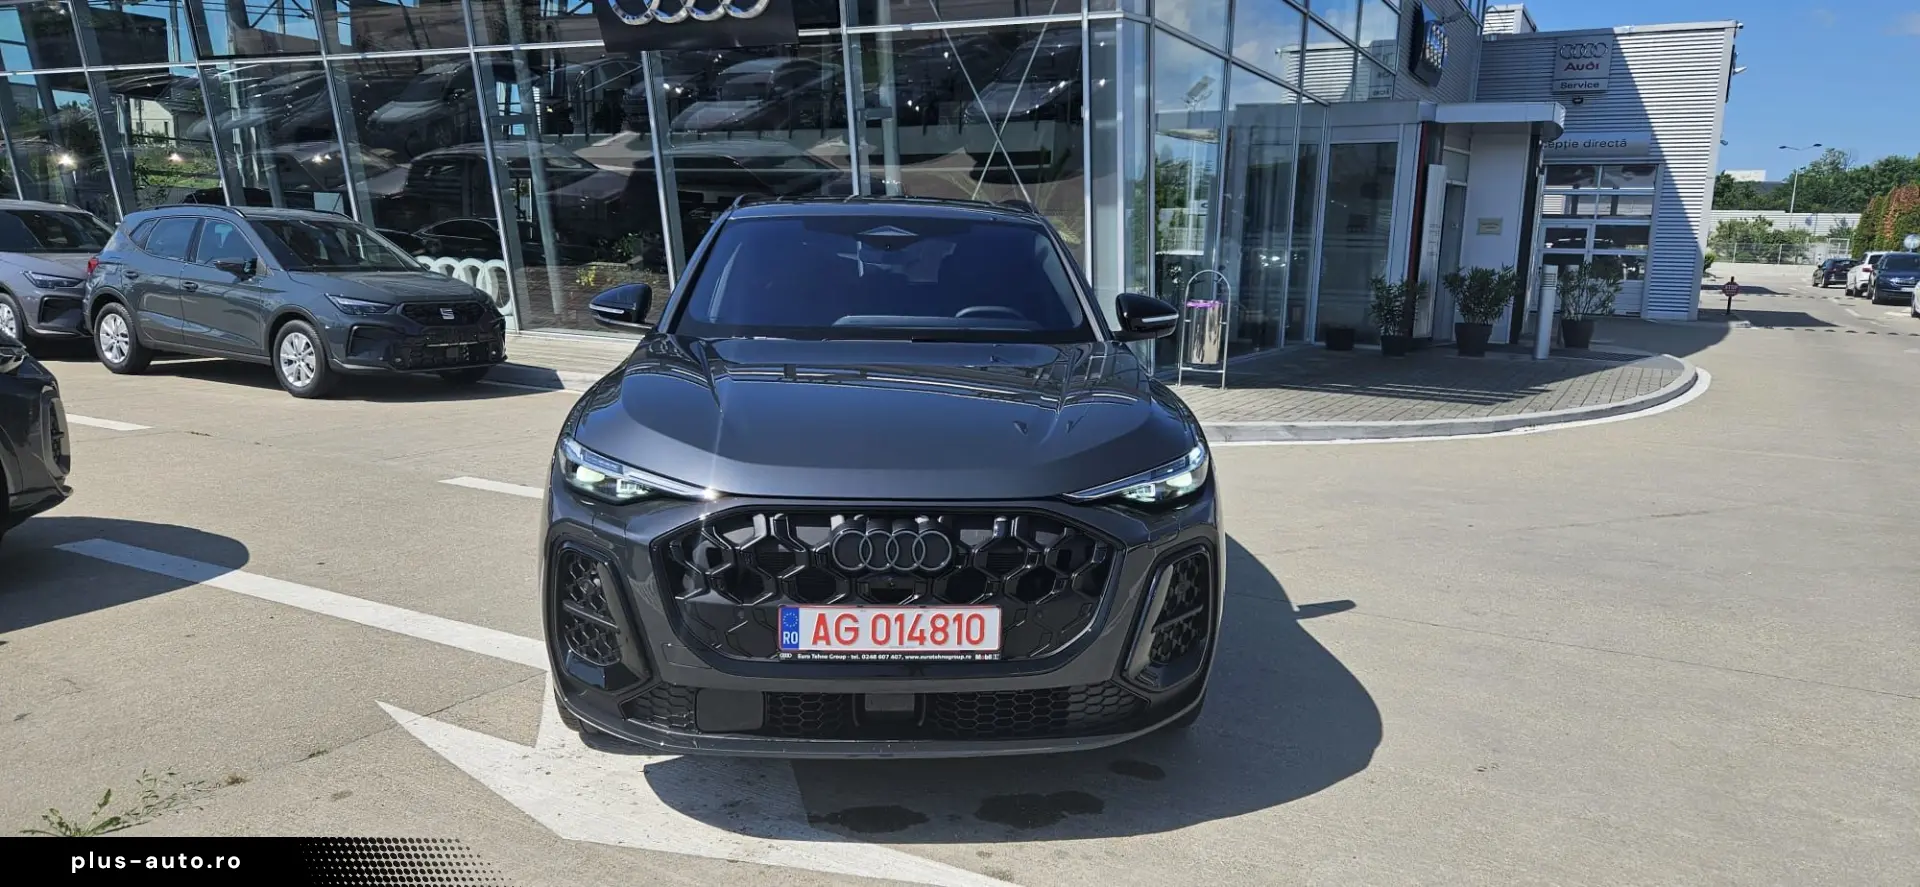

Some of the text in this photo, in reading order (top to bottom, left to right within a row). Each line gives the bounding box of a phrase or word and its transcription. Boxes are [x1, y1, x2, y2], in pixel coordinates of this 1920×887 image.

[1563, 61, 1600, 72] Audi
[1560, 81, 1600, 89] Service
[811, 612, 985, 646] AG 014810
[783, 631, 799, 645] RO
